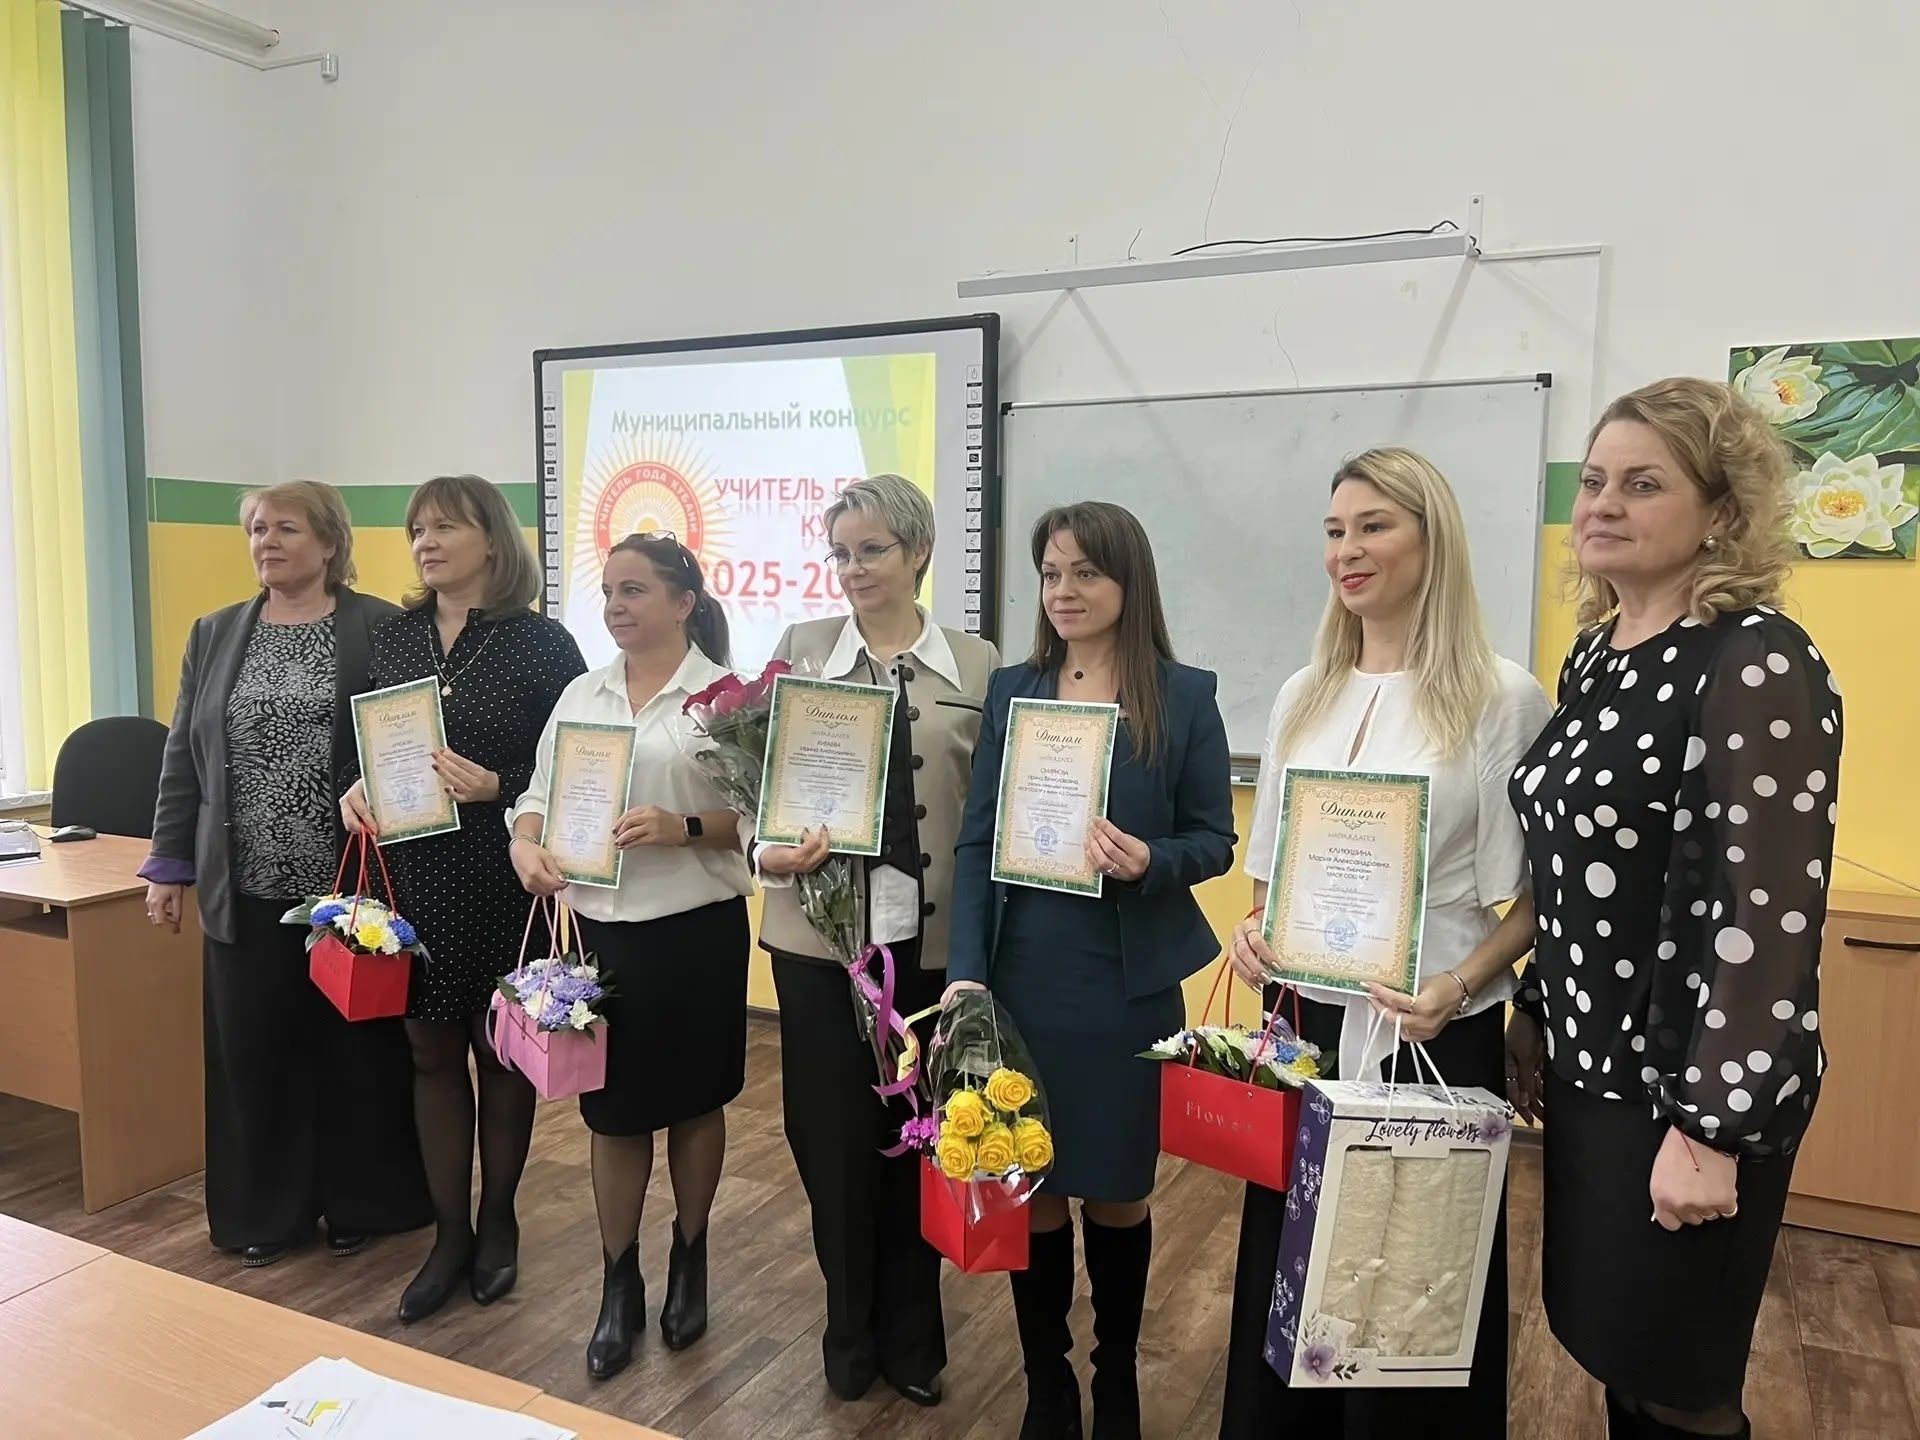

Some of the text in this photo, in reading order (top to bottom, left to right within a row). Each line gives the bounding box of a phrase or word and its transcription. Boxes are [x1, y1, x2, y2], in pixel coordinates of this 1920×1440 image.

[611, 402, 912, 438] Муниципальный конкурс
[599, 469, 699, 533] УЧИТЕЛЬ ГОДА КУБАНИ
[713, 477, 825, 501] УЧИТЕЛЬ
[702, 560, 846, 600] 025-20
[805, 704, 859, 722] Диплом
[1035, 728, 1082, 744] Диплом
[1319, 799, 1387, 819] Диплом
[1364, 1115, 1481, 1146] Lovely flowers
